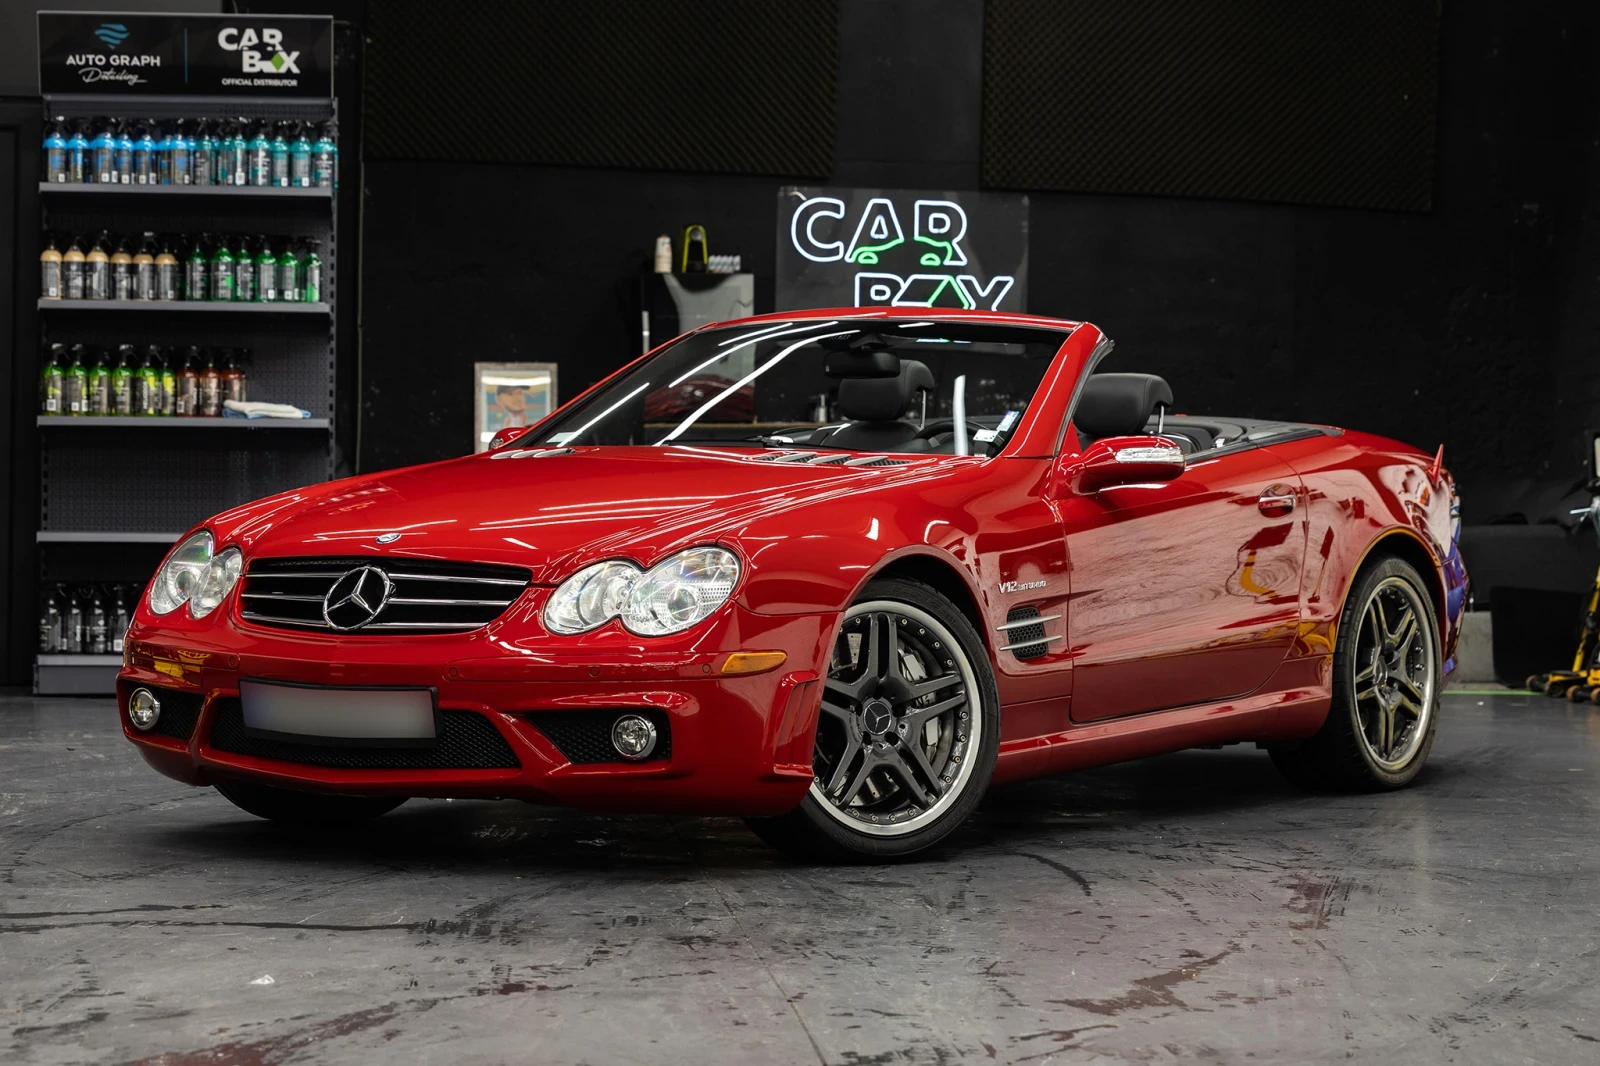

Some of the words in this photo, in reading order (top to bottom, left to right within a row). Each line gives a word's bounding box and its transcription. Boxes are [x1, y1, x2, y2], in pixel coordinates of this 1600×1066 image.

[218, 27, 284, 51] CAR
[66, 54, 106, 66] AUTO
[109, 54, 160, 67] GRAPH
[242, 50, 301, 74] BOX
[78, 67, 148, 86] Detailing
[221, 78, 253, 86] OFFICIAL
[253, 79, 298, 87] DISTRIBUTOR
[791, 197, 968, 266] CAR
[998, 581, 1017, 593] V12
